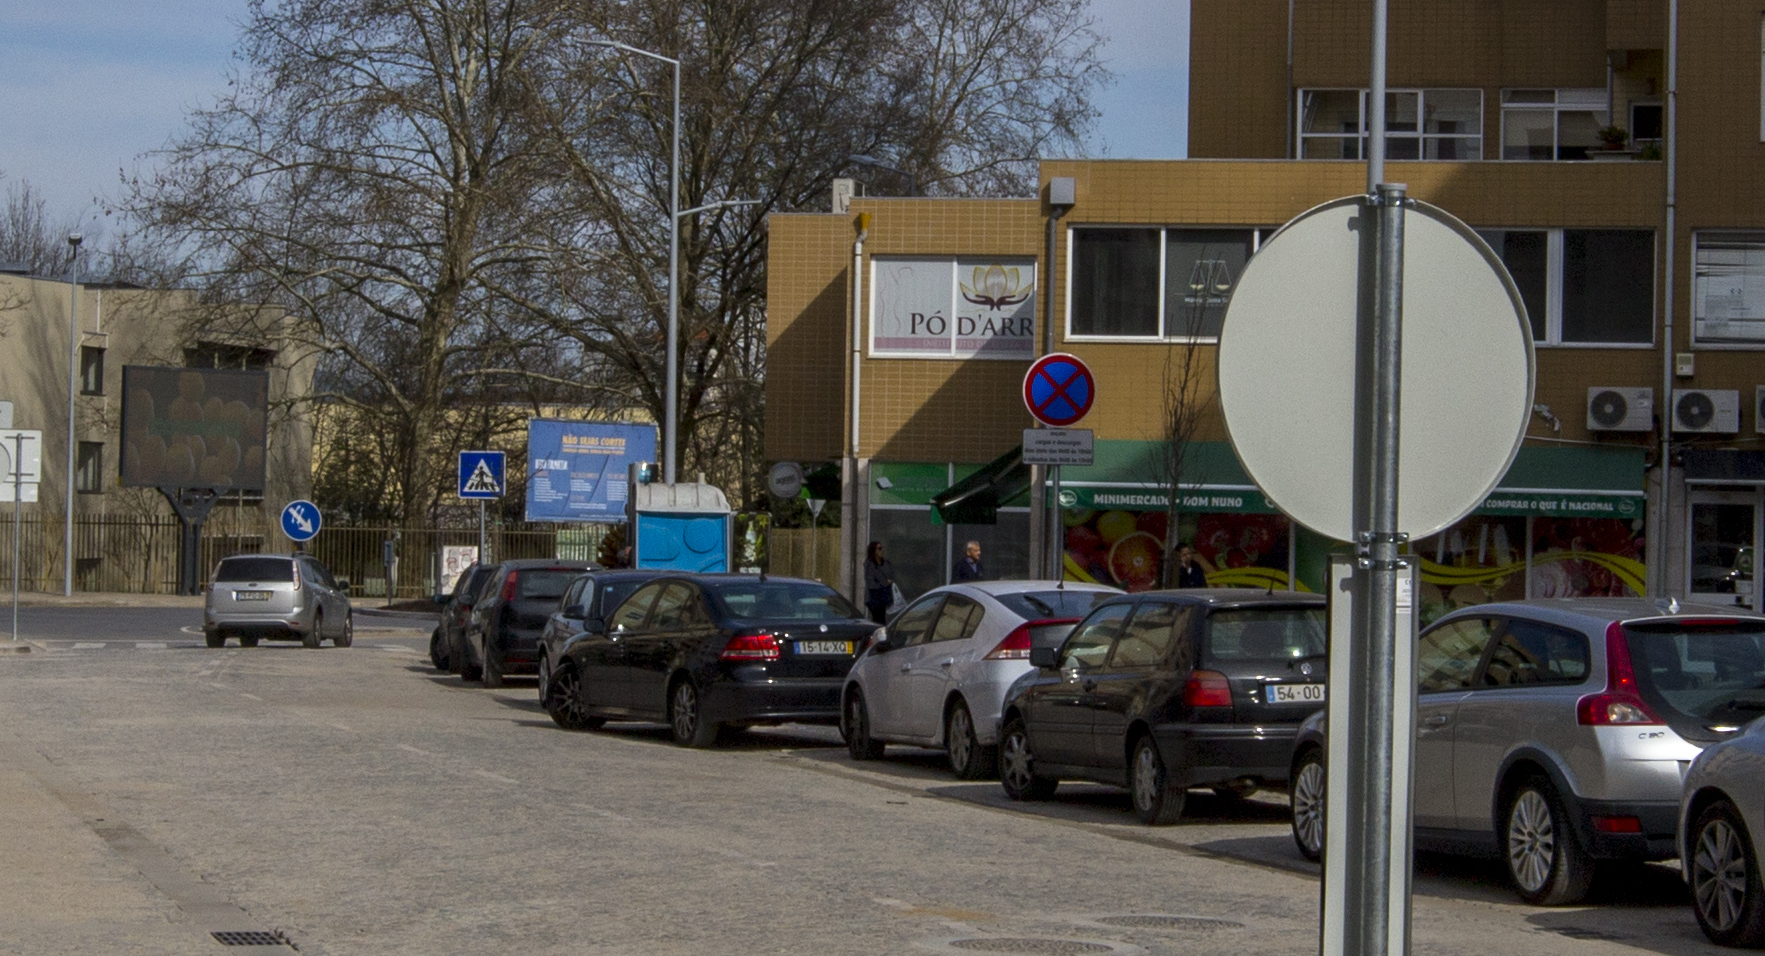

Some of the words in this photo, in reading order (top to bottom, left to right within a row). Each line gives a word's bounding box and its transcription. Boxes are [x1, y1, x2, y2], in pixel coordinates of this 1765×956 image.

[910, 311, 946, 336] PÓ
[1211, 497, 1243, 508] NUNO
[1486, 500, 1529, 509] COMPRAR
[1539, 501, 1557, 511] QUE
[1561, 499, 1567, 510] É
[1569, 502, 1614, 511] NACIONAL
